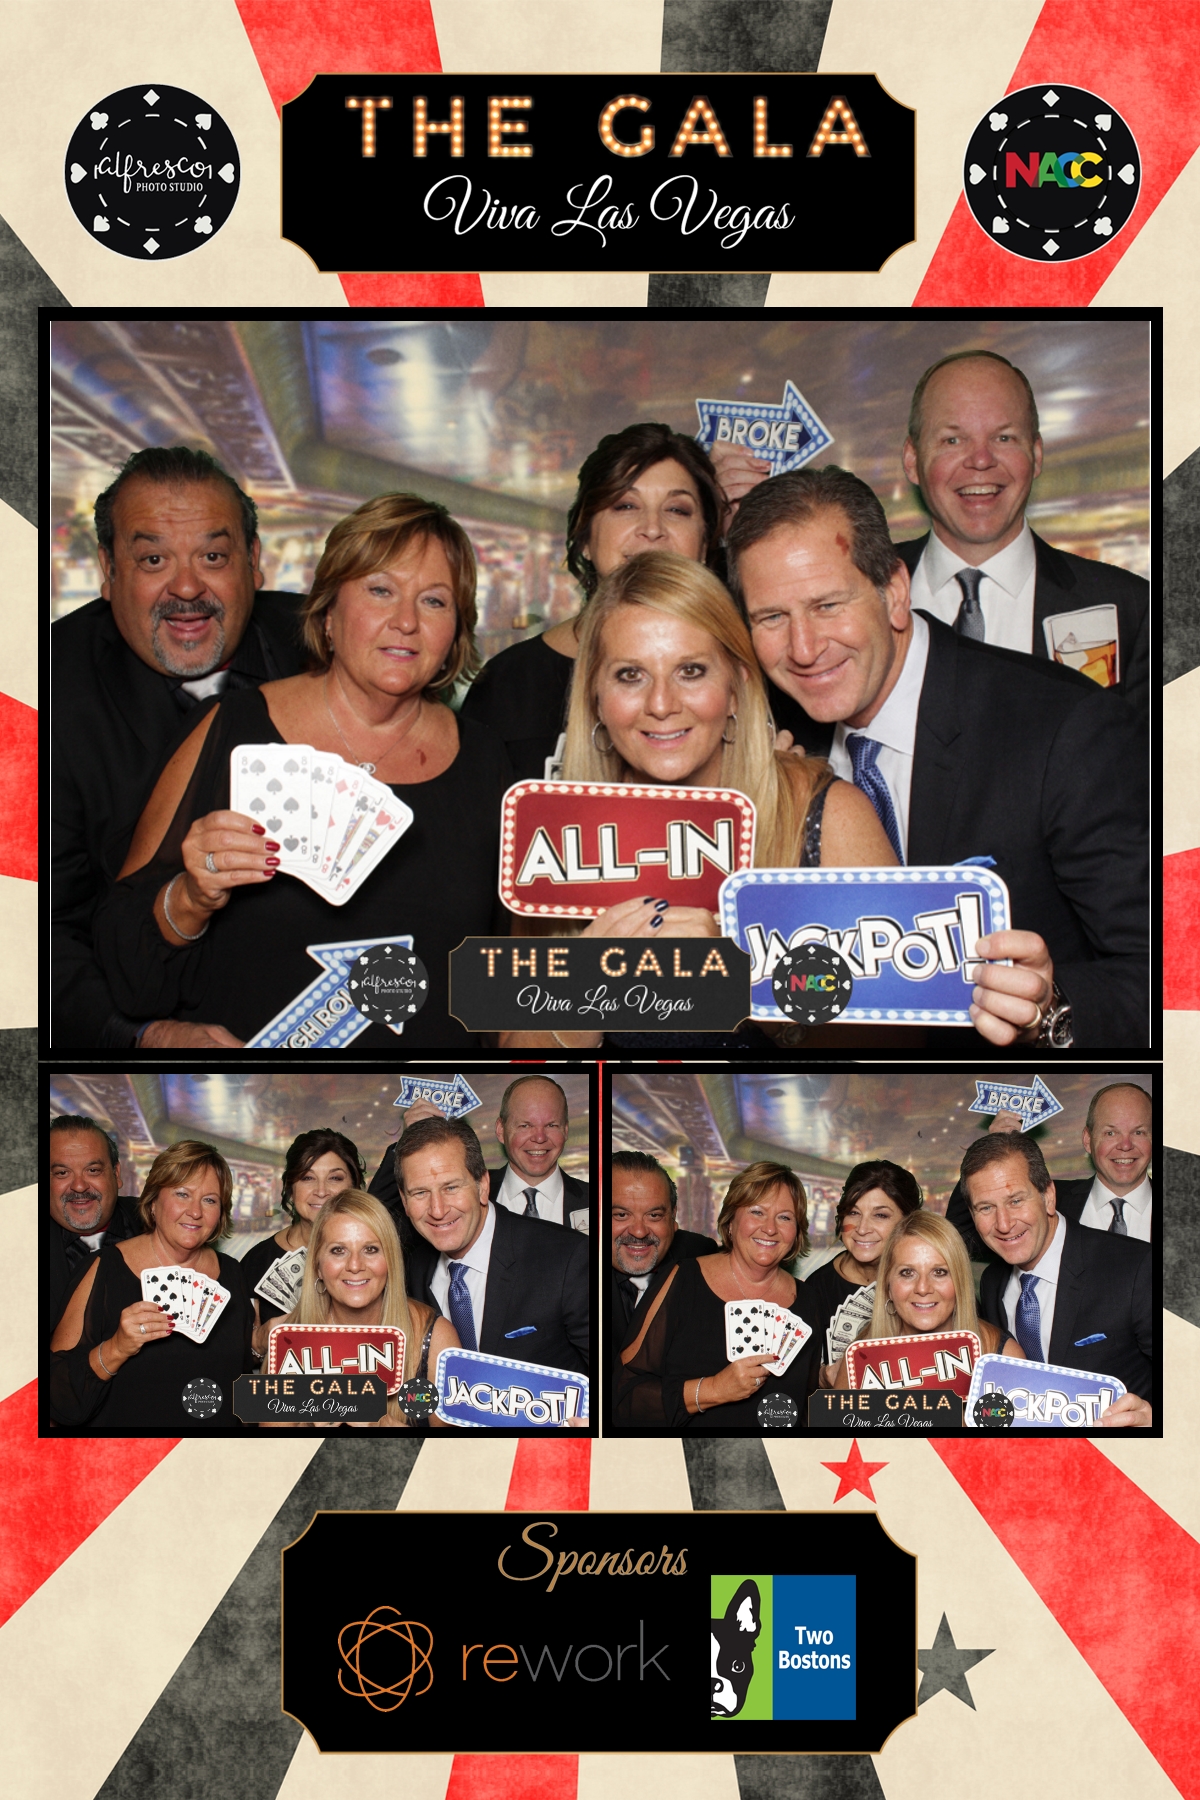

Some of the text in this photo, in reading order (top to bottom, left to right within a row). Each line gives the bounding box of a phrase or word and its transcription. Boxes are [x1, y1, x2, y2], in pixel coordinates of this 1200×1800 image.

[716, 415, 803, 451] BROKE
[516, 819, 736, 885] ALL-IN
[411, 1086, 464, 1109] BROKE
[987, 1090, 1045, 1114] BROKE
[278, 1342, 394, 1375] ALL-IN
[859, 1346, 974, 1390] ALL-IN
[444, 1376, 580, 1427] JACKPOT!
